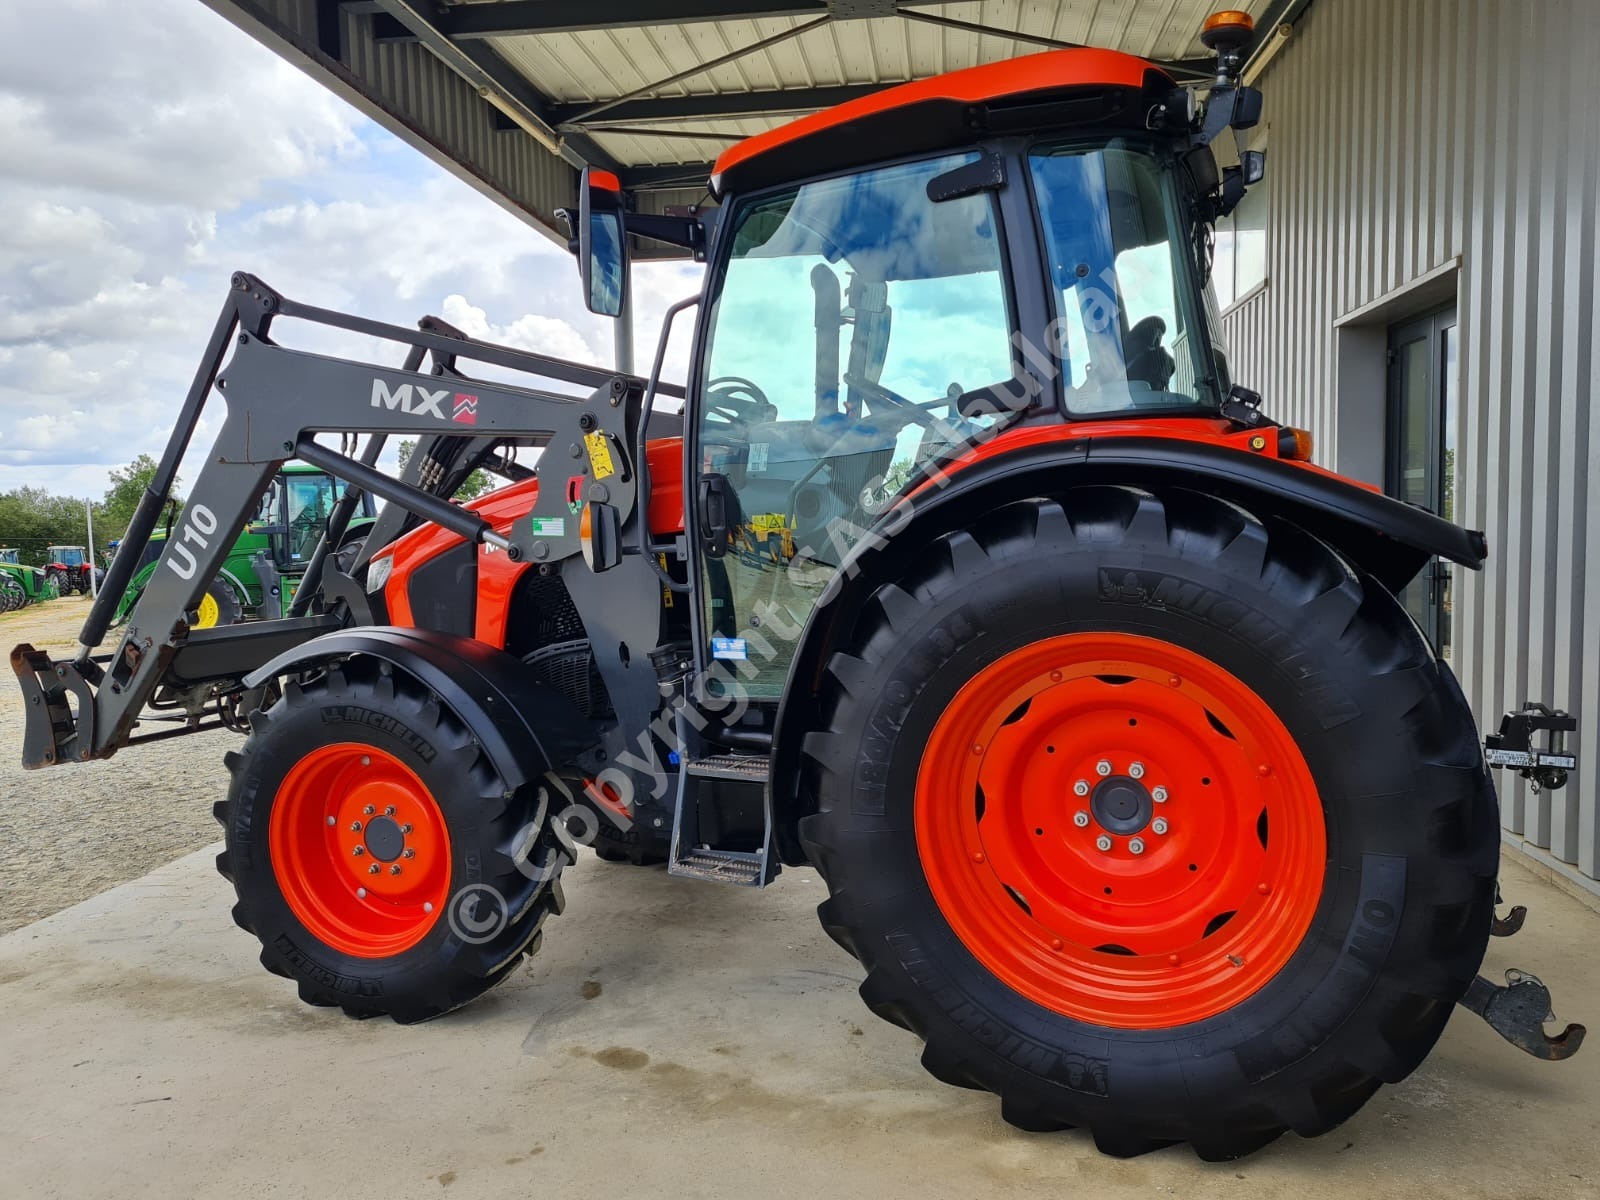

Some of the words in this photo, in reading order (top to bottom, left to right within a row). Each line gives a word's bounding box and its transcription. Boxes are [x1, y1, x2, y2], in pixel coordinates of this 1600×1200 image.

[371, 378, 449, 419] MX
[167, 504, 217, 579] U10
[1150, 575, 1357, 724] MICHELIN
[345, 707, 435, 761] MICHELIN
[276, 937, 360, 993] MICHELIN
[885, 924, 1057, 1077] MICHELIN
